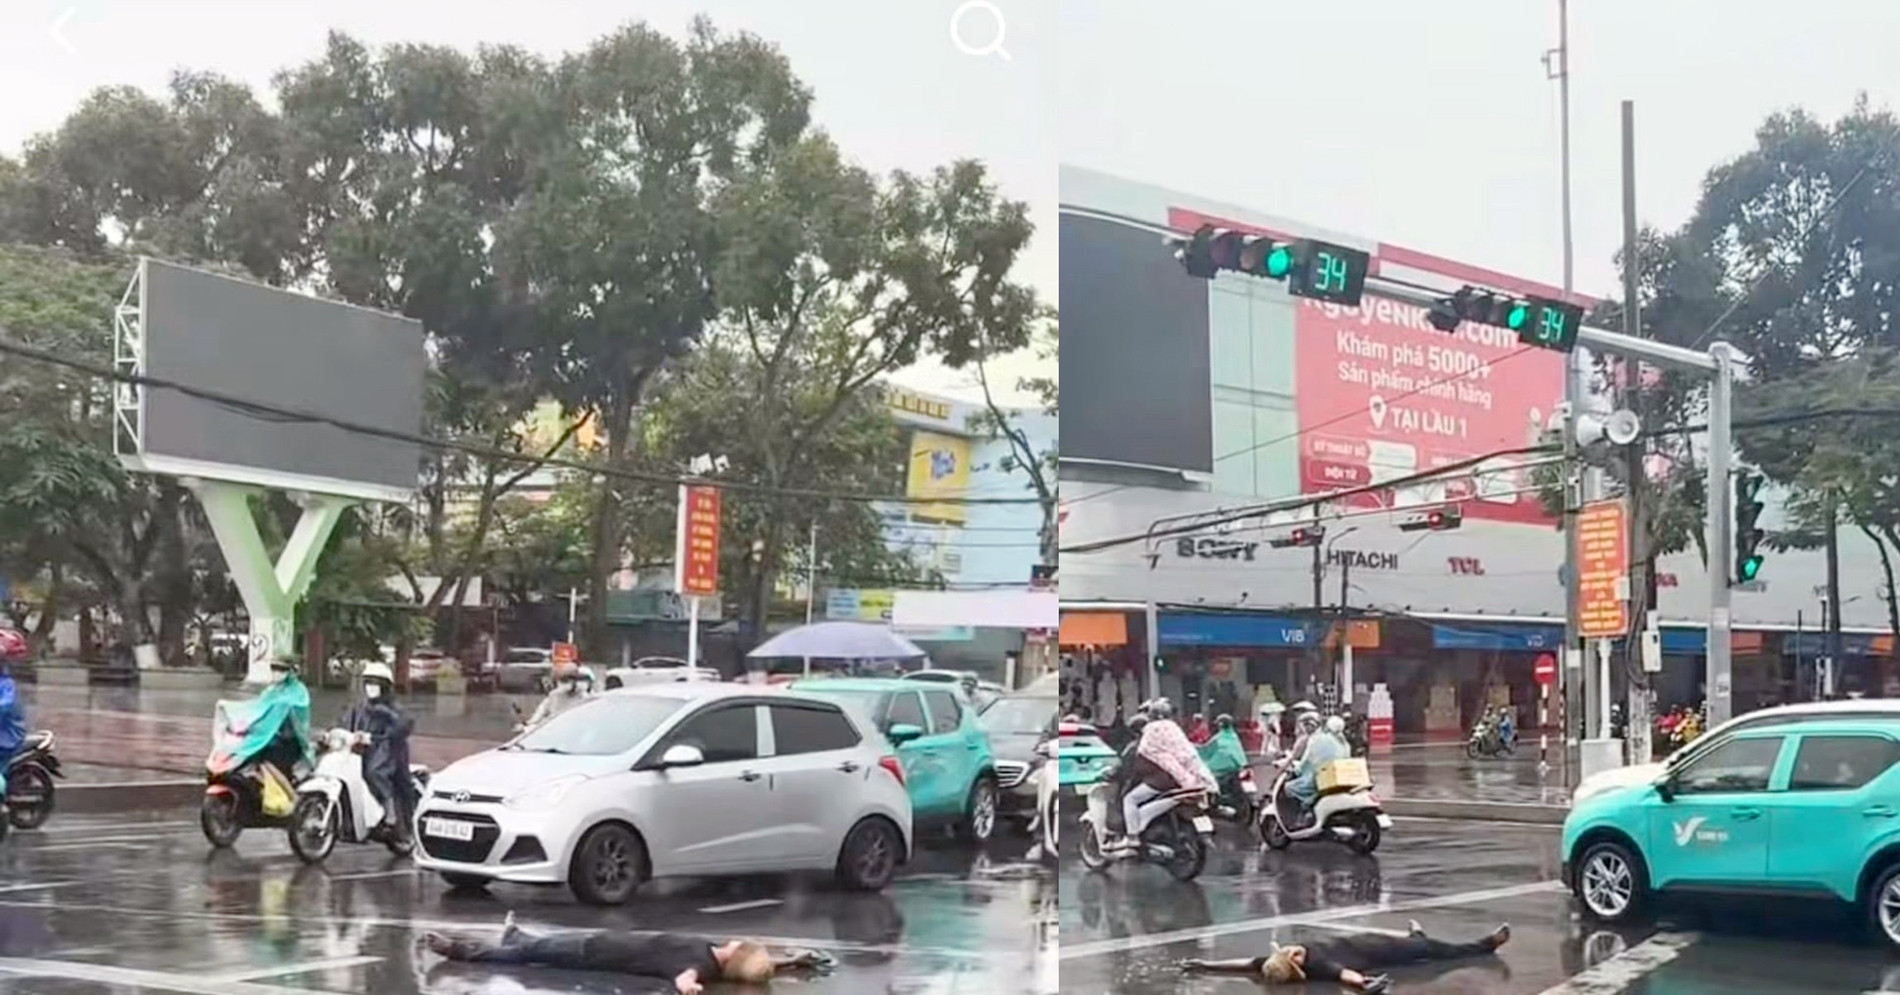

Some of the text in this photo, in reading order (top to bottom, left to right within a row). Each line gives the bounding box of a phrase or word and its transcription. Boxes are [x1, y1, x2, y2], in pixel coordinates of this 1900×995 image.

[1315, 252, 1347, 291] 34
[1538, 306, 1565, 342] 34
[1337, 330, 1492, 380] Khám phá 5000+
[1391, 406, 1418, 433] TẠI
[1459, 418, 1467, 440] 1
[1326, 549, 1399, 570] HITACHI
[1447, 556, 1486, 576] TCL
[1280, 628, 1305, 644] VIB
